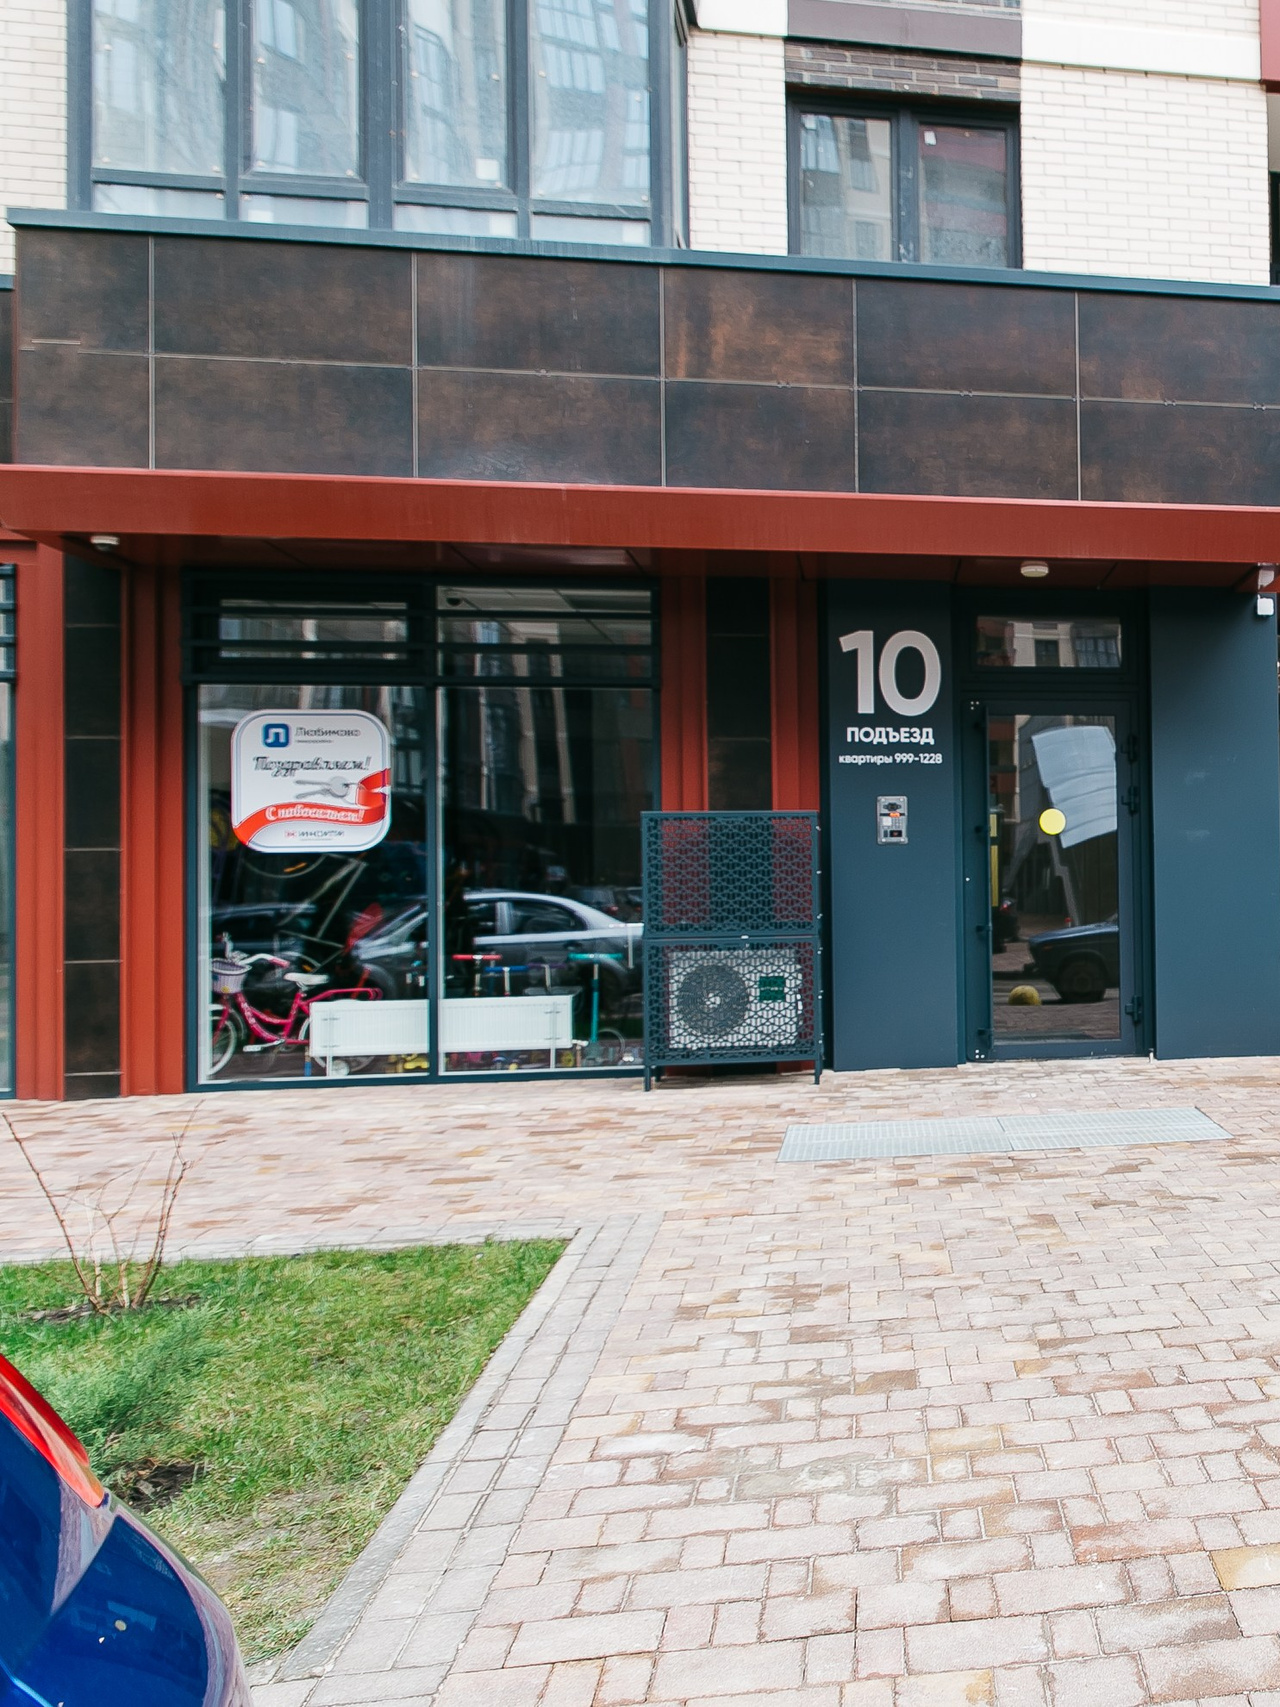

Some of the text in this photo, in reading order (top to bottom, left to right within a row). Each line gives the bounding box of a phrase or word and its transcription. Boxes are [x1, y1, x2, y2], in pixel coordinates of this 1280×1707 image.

[839, 630, 941, 716] 10
[846, 727, 934, 745] ПОДЪЕЗД
[253, 756, 372, 778] Поздравляем!
[838, 753, 943, 765] квартиры 999-1228
